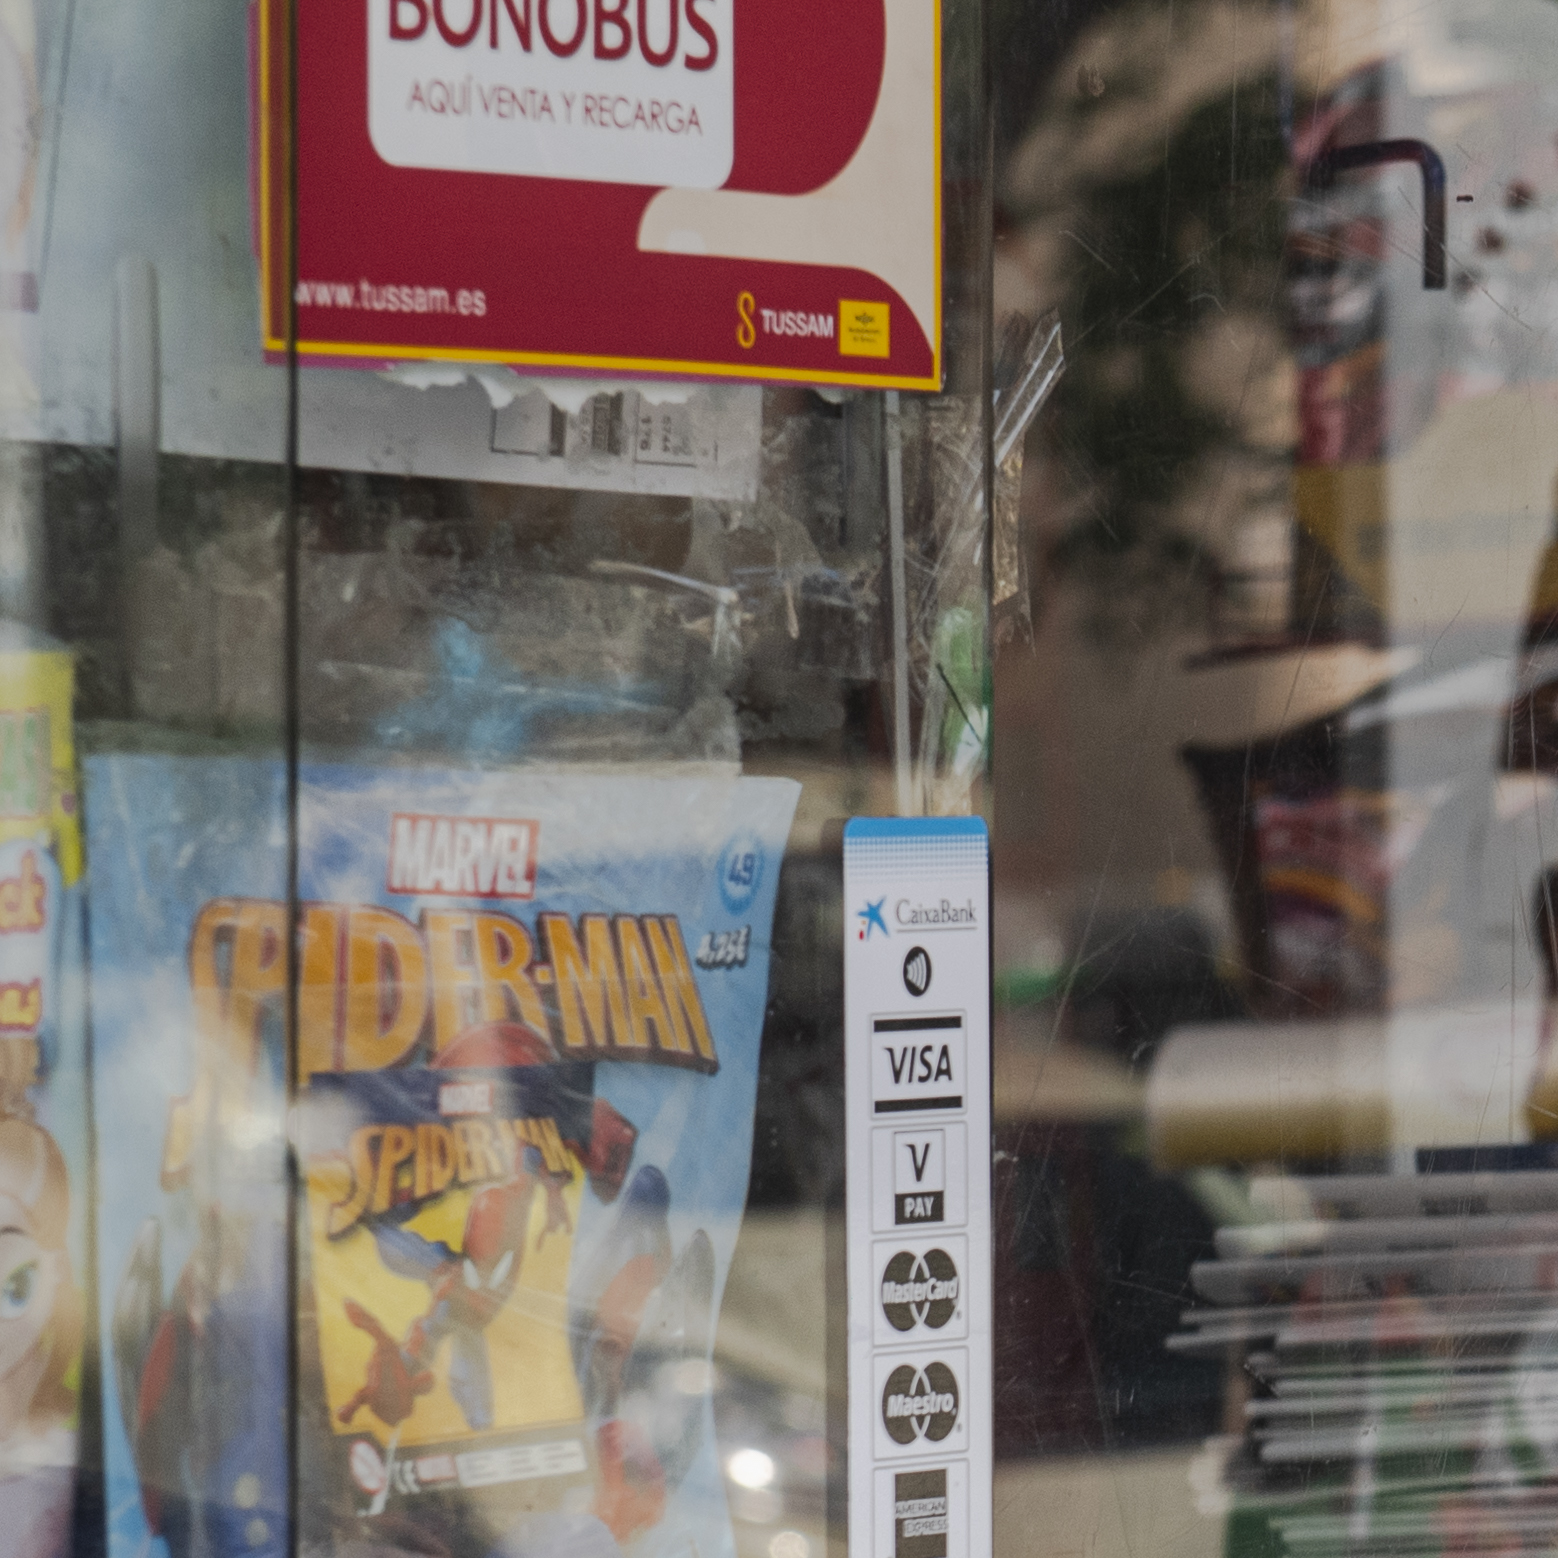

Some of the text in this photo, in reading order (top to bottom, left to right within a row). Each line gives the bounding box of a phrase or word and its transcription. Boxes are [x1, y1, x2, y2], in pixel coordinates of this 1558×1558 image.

[408, 75, 704, 137] AQUÍ VENTA Y RECARGA
[293, 277, 488, 317] www.tussam.es
[760, 307, 835, 339] TUSSAM
[391, 816, 533, 895] MARVEL
[728, 852, 756, 889] 49
[894, 899, 978, 926] CaixaBank
[170, 898, 721, 1110] SPIDER-MAN
[884, 1044, 953, 1085] VISA
[327, 1115, 576, 1240] SPIDER-MAN
[905, 1142, 931, 1183] V
[903, 1196, 935, 1220] PAY
[882, 1275, 960, 1305] MasterCard
[886, 1389, 956, 1419] Maestro
[895, 1500, 946, 1515] AMERICAN
[904, 1517, 949, 1535] EXPRESS
